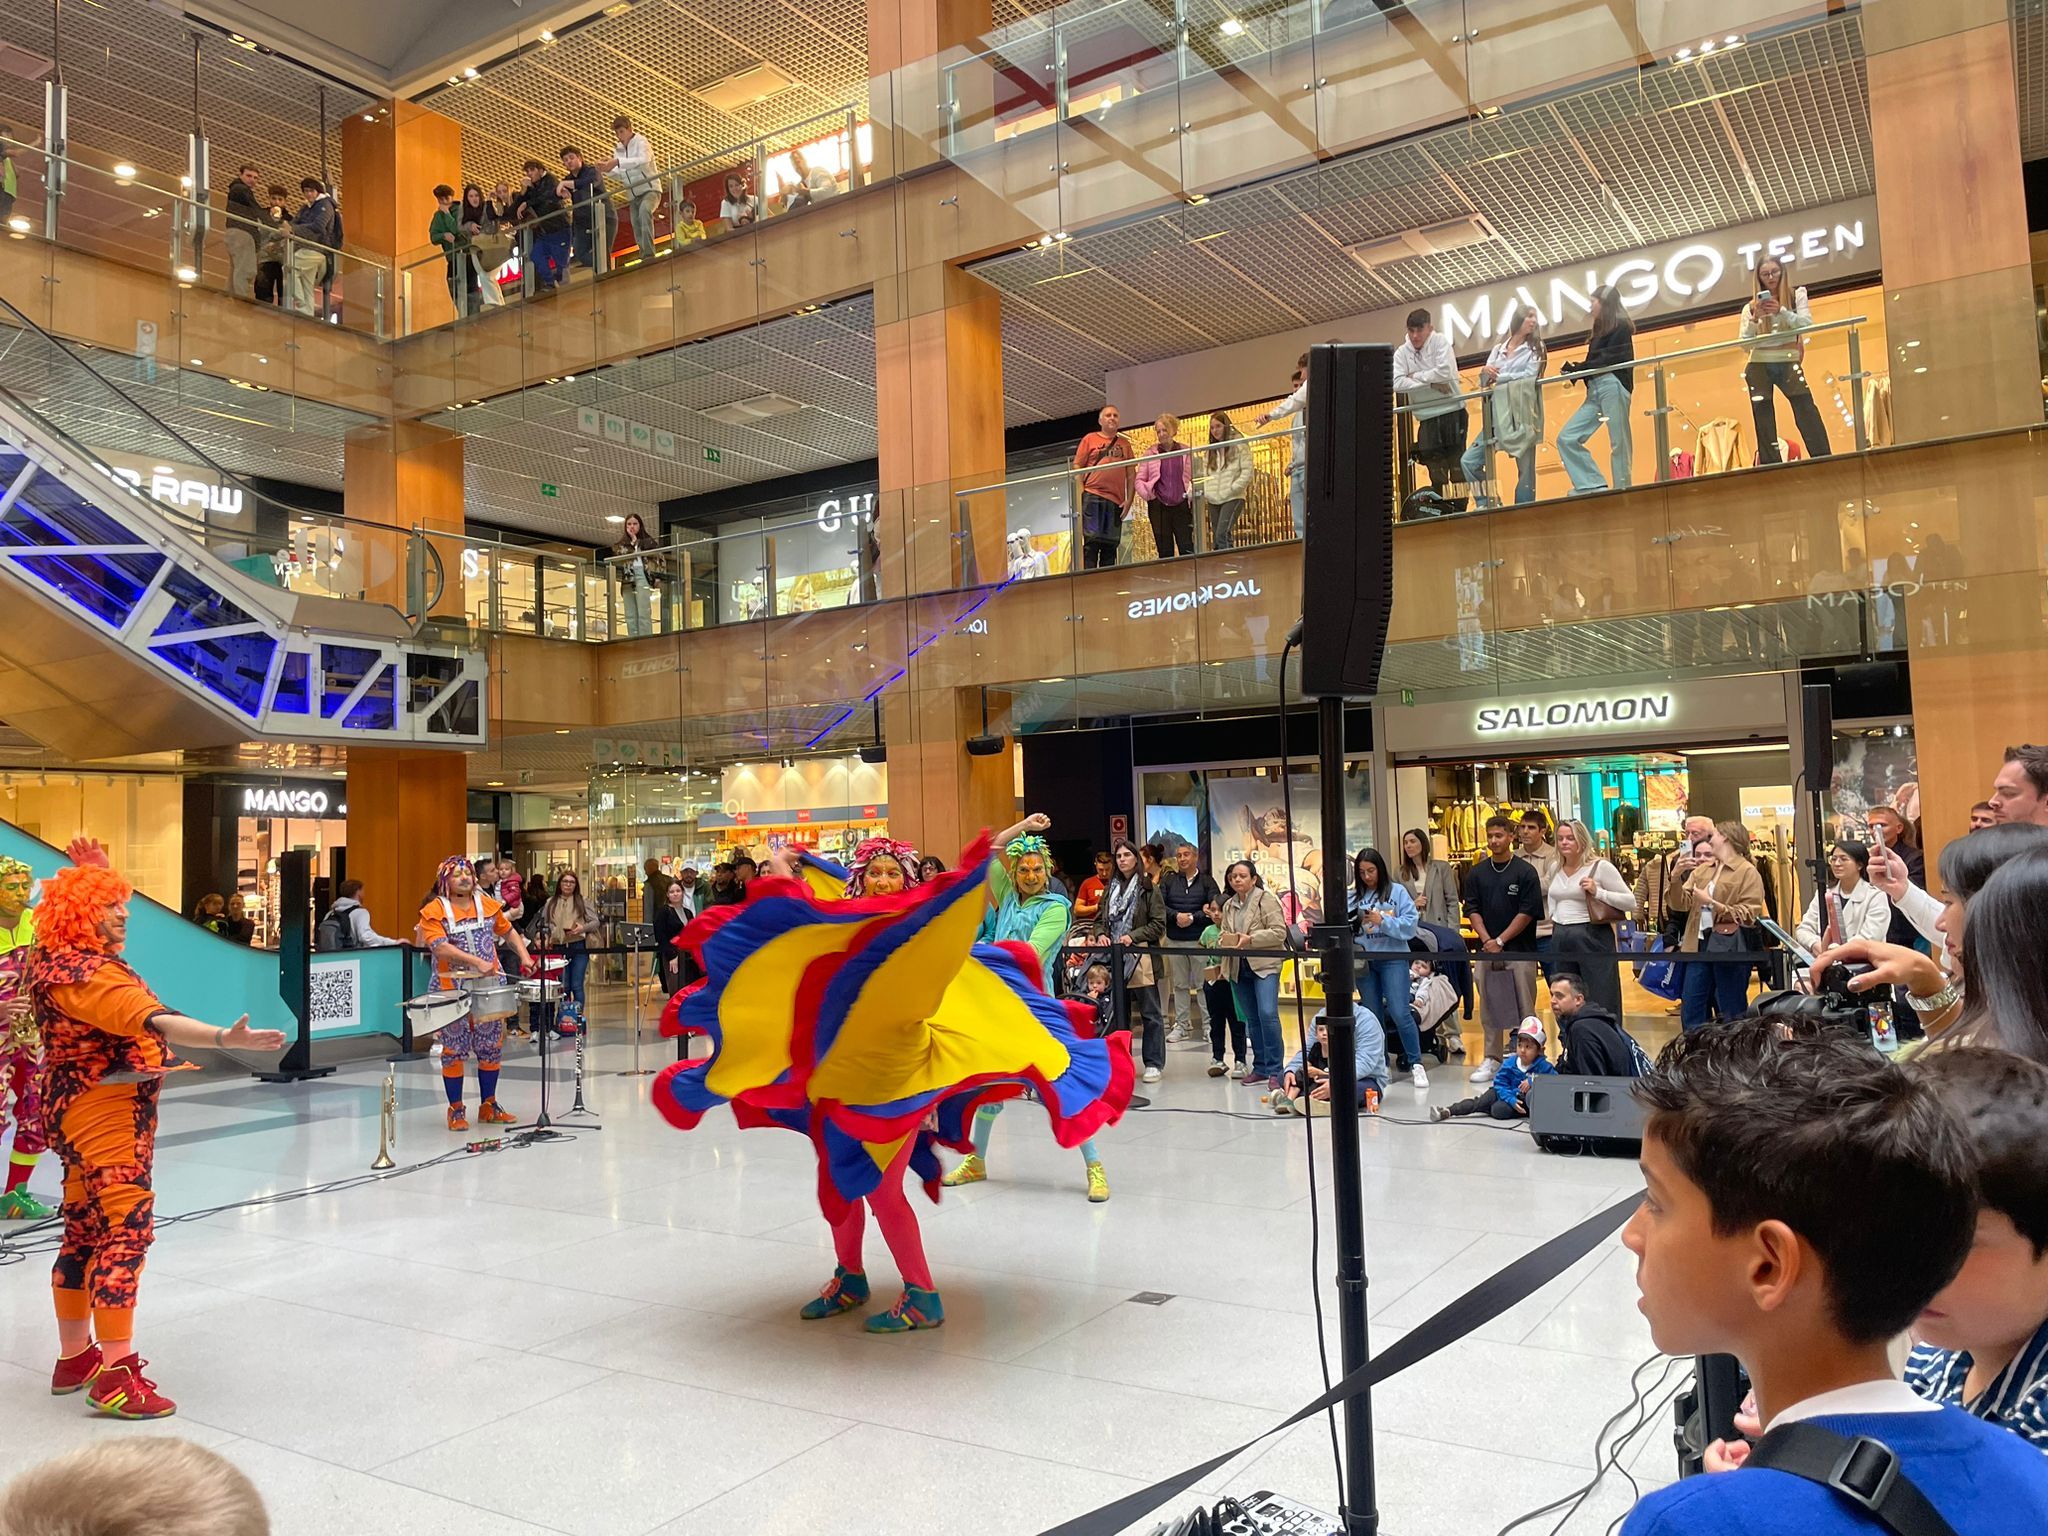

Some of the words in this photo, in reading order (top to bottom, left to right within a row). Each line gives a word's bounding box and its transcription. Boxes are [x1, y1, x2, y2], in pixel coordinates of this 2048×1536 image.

[1441, 244, 1726, 347] MANGO
[1737, 219, 1865, 272] TEEN
[151, 474, 243, 514] RAW
[1476, 695, 1670, 731] SALOMON
[244, 788, 329, 813] MANGO
[1224, 850, 1248, 861] LET
[1250, 849, 1270, 861] GO
